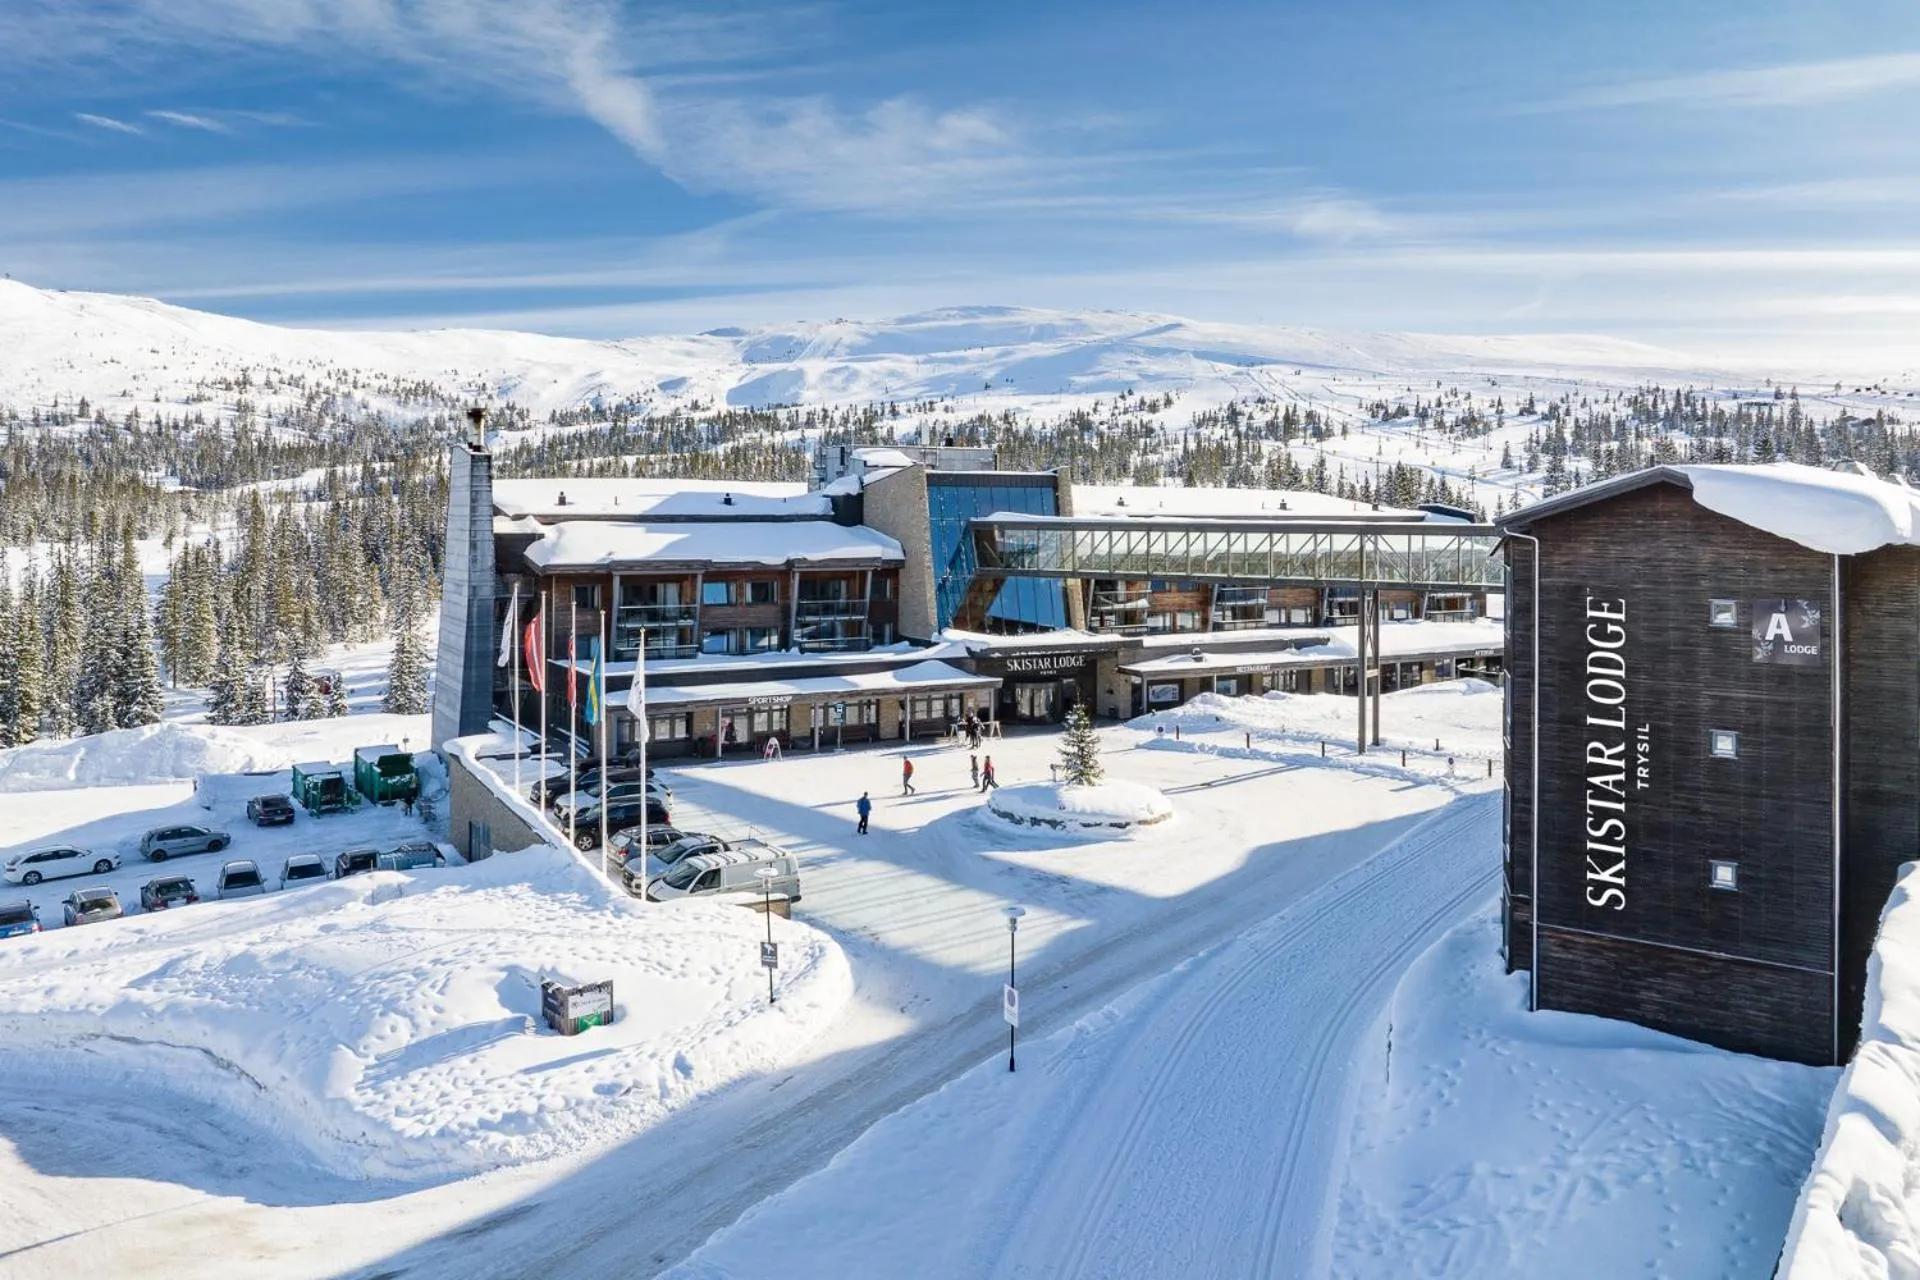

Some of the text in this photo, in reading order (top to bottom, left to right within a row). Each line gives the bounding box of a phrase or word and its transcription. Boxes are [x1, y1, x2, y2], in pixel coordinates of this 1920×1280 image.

[1765, 612, 1793, 642] A
[1784, 644, 1818, 655] LODGE
[1006, 655, 1087, 671] SKISTAR LODGE
[748, 695, 793, 705] SPORTSHOP
[1586, 596, 1626, 911] SKISTAR LODGE
[1636, 722, 1650, 790] TRYSIL
